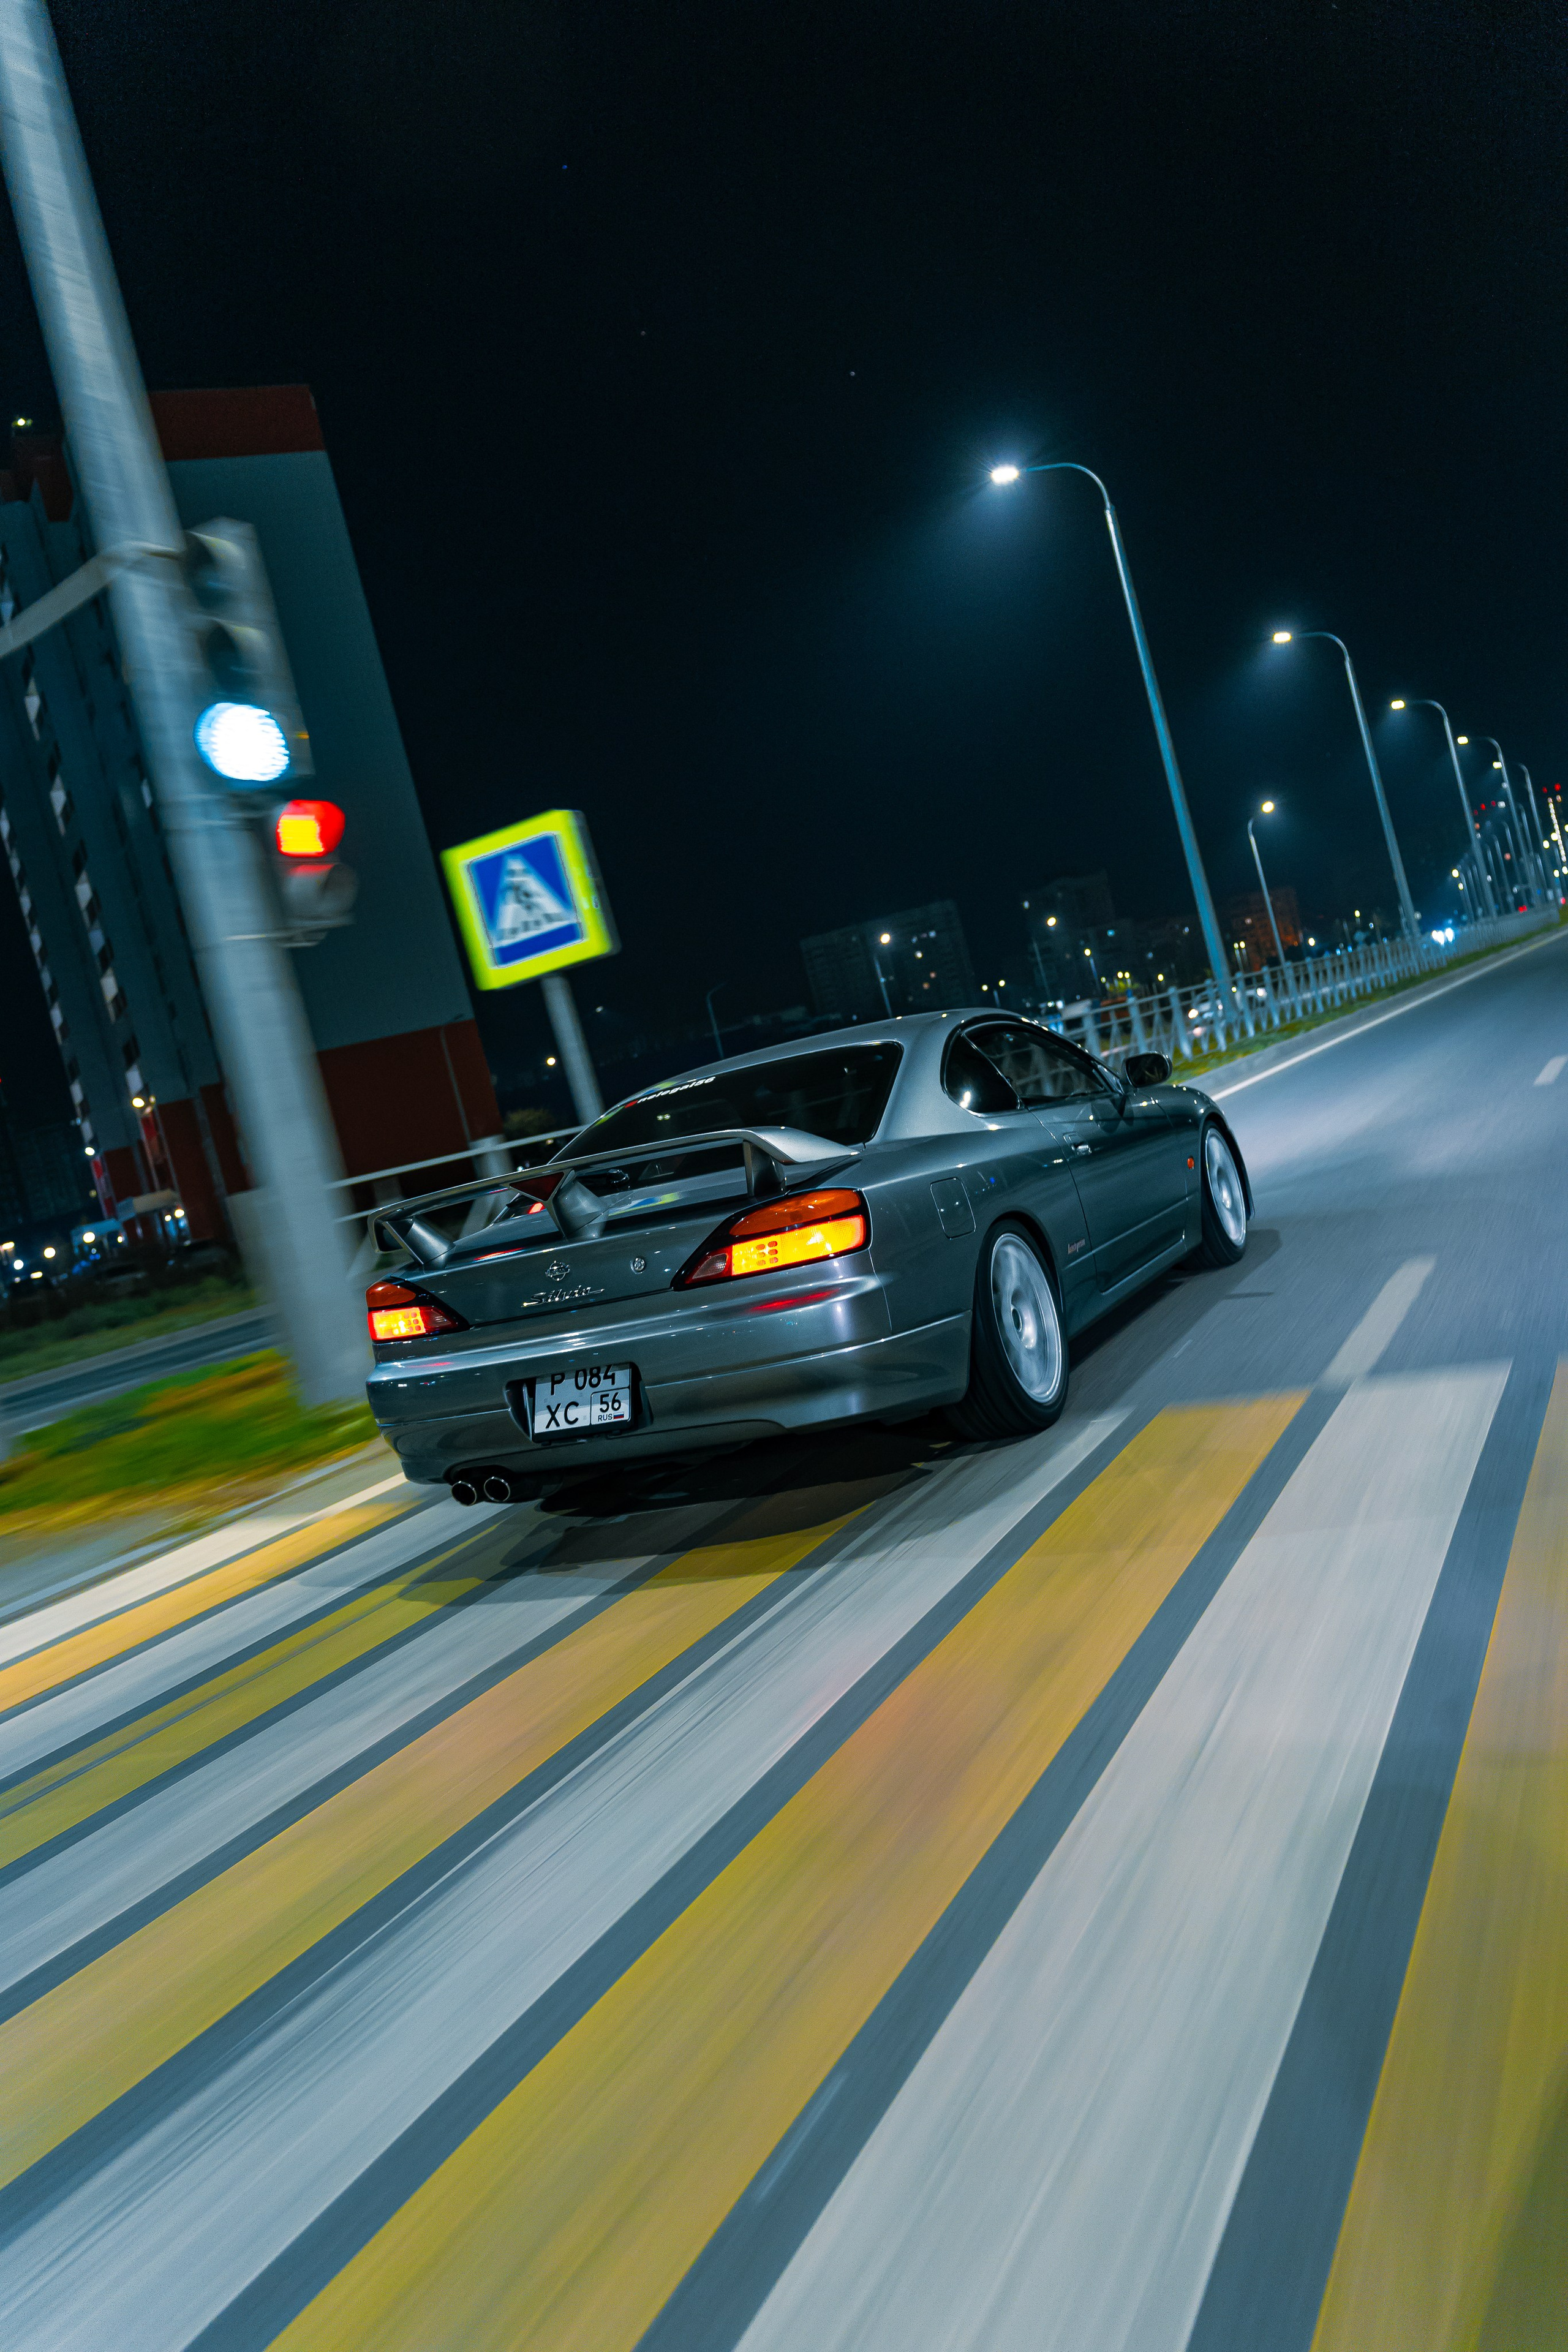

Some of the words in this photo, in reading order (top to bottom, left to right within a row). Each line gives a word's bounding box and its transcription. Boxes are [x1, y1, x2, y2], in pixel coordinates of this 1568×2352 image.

[575, 1364, 616, 1390] 084
[600, 1392, 622, 1412] 56
[598, 1413, 613, 1422] RUS
